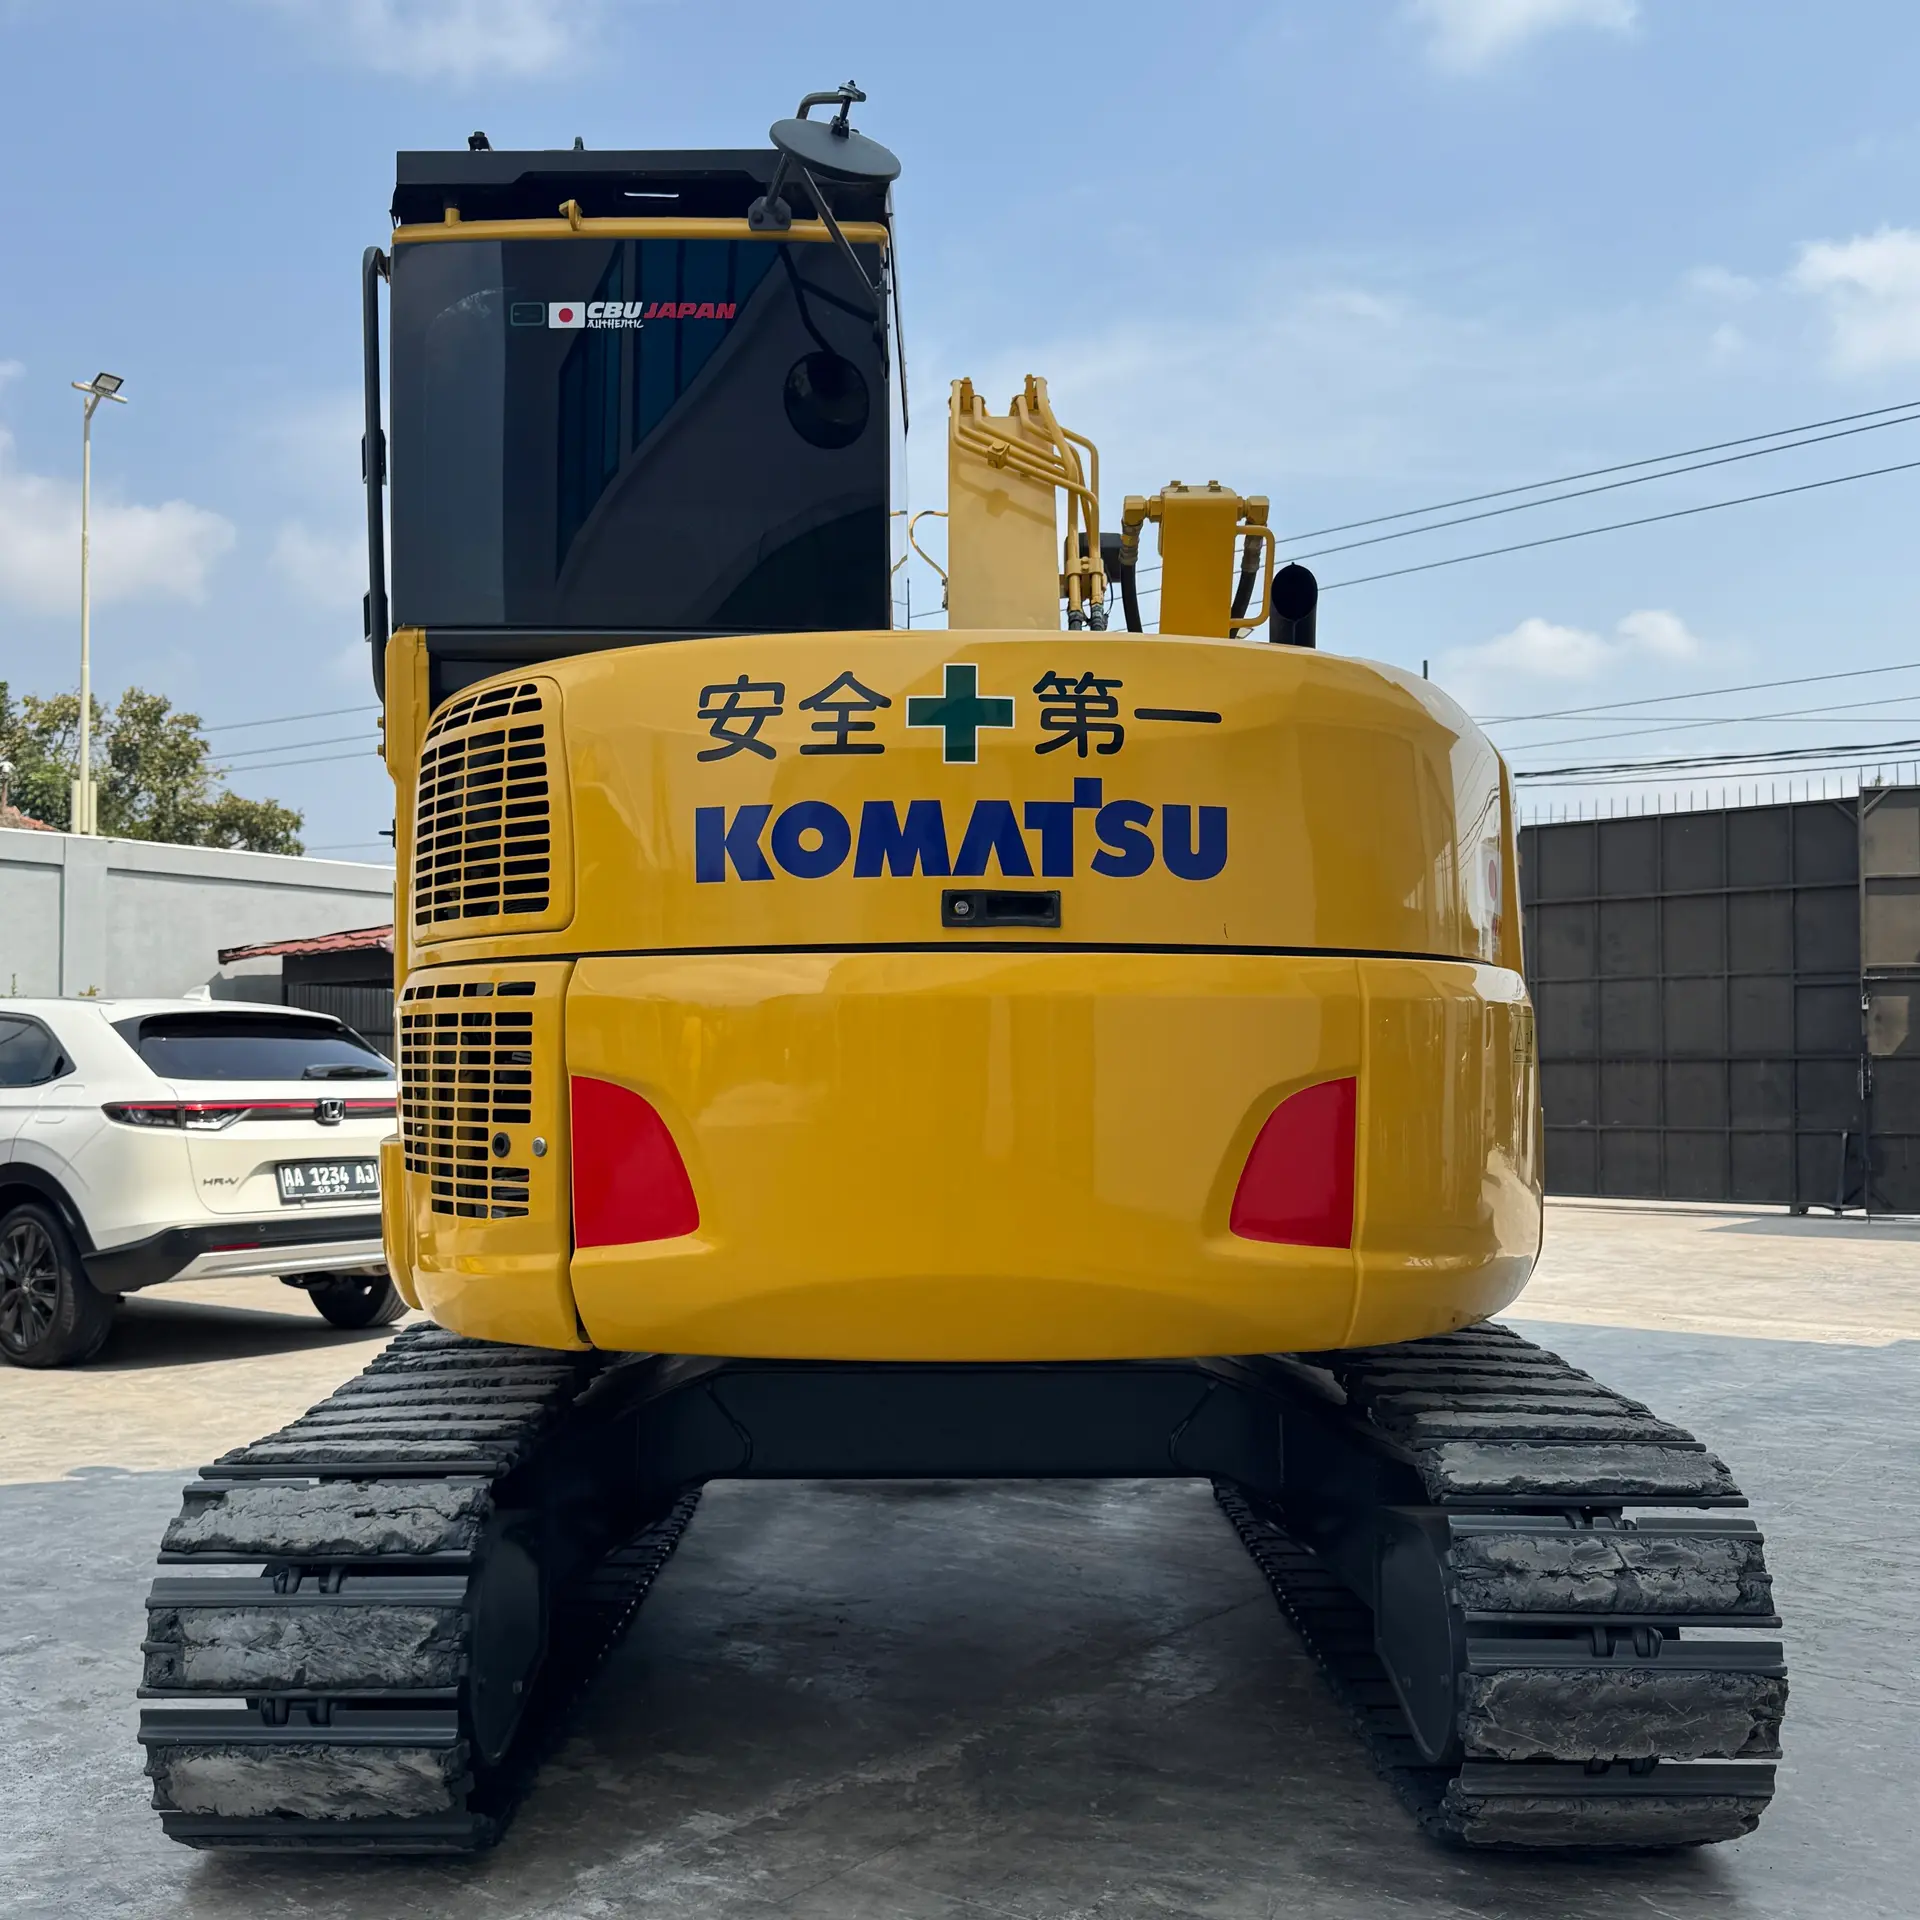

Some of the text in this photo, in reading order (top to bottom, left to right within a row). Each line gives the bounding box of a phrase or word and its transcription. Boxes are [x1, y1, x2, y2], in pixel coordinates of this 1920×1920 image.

[586, 302, 737, 319] CBU JAPAN
[586, 319, 645, 330] AUTHENTIC
[697, 670, 1223, 763] 安全 第一
[695, 777, 1228, 883] KOMATSU
[284, 1164, 375, 1187] AA 1234 AJ
